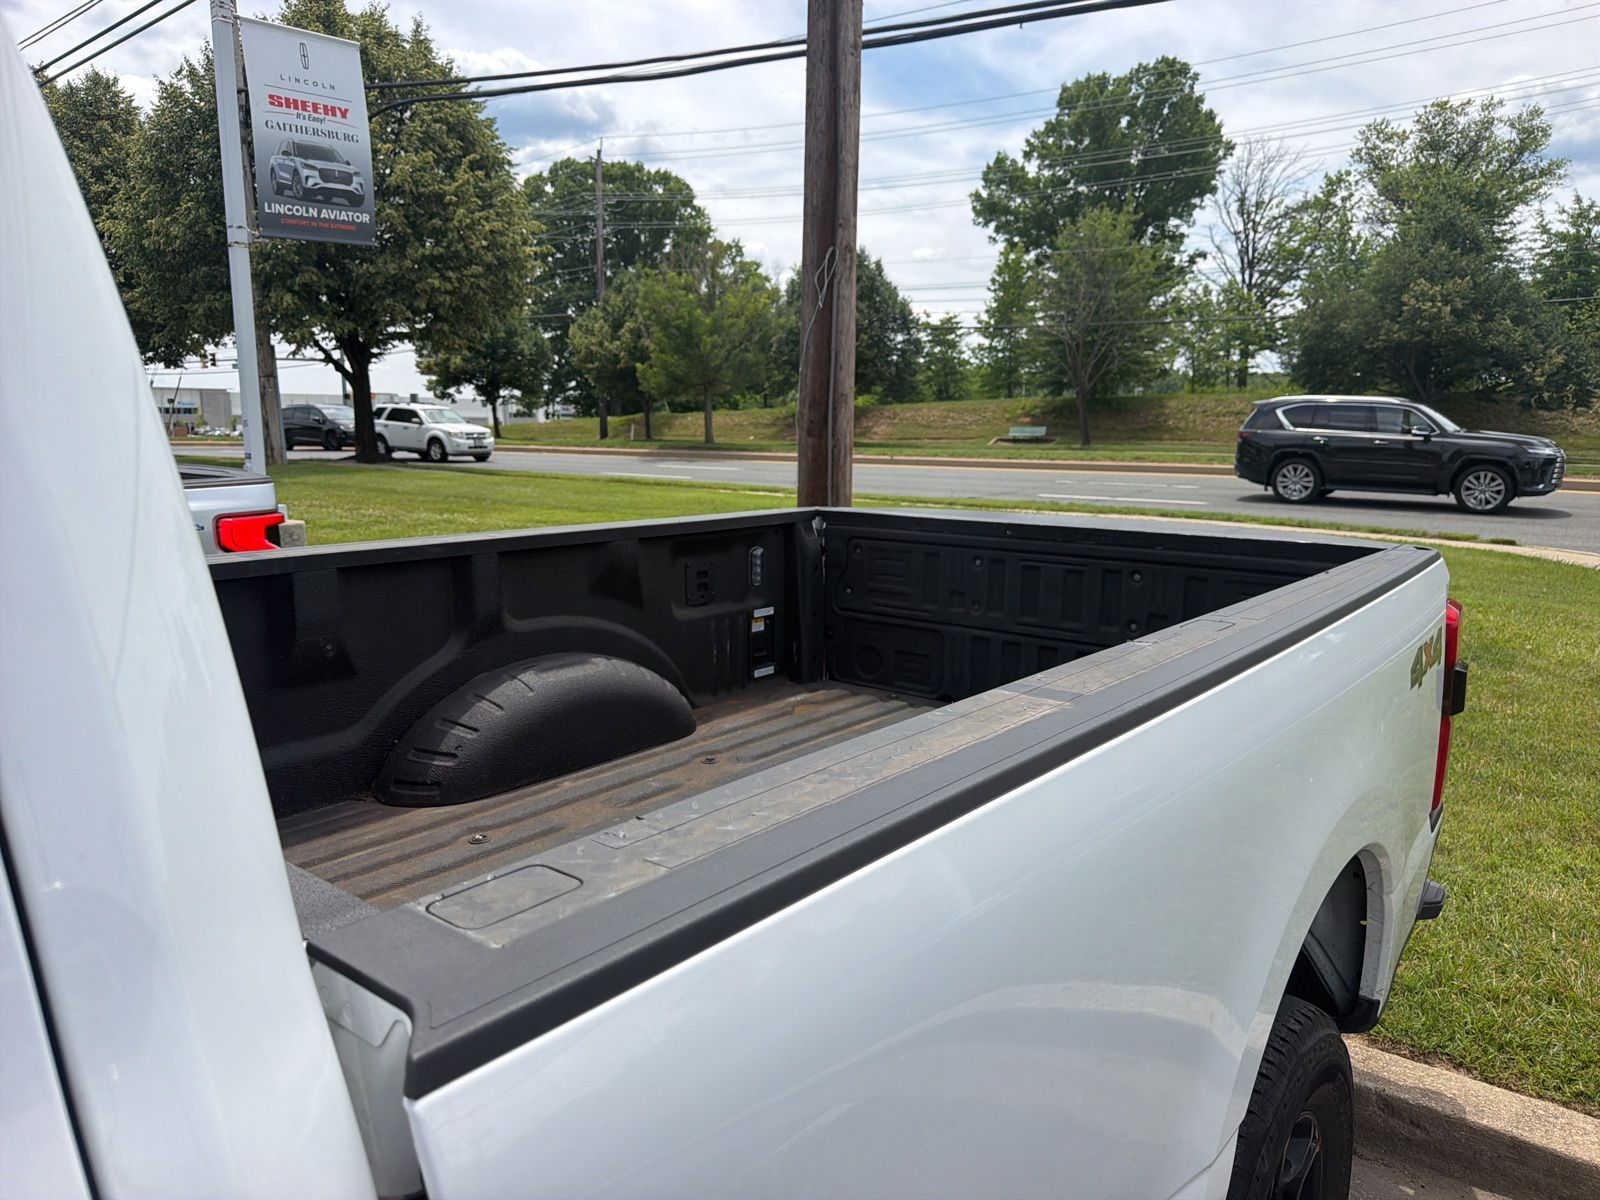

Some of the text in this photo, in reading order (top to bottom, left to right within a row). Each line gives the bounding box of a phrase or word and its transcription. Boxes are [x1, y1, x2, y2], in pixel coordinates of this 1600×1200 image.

[280, 74, 336, 90] LINCOLN
[268, 94, 350, 119] SHEEHY
[296, 112, 326, 125] It's Easy!
[265, 120, 359, 143] GAITHERSBURG
[264, 202, 370, 224] LINCOLN AVIATOR
